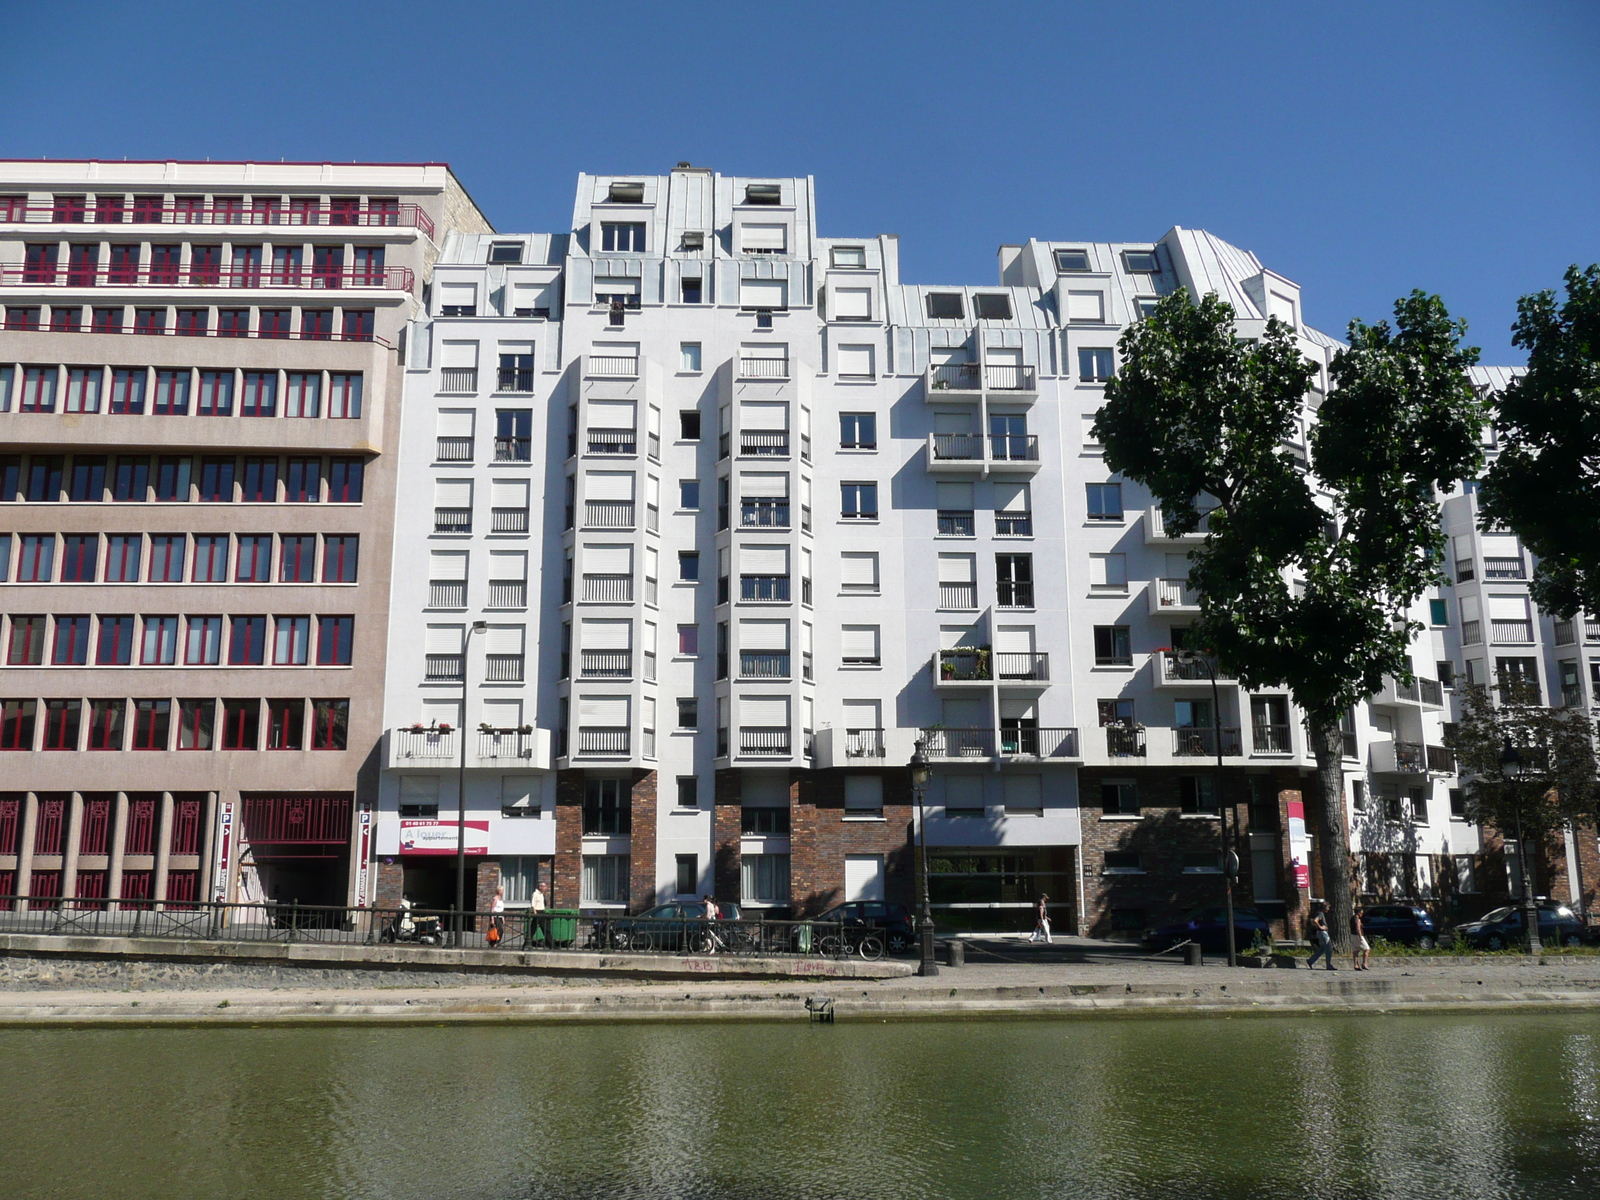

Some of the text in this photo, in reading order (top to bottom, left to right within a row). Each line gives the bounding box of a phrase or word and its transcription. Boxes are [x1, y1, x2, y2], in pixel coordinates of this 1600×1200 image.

[223, 815, 230, 823] P
[361, 815, 368, 823] P
[405, 829, 447, 839] A louer
